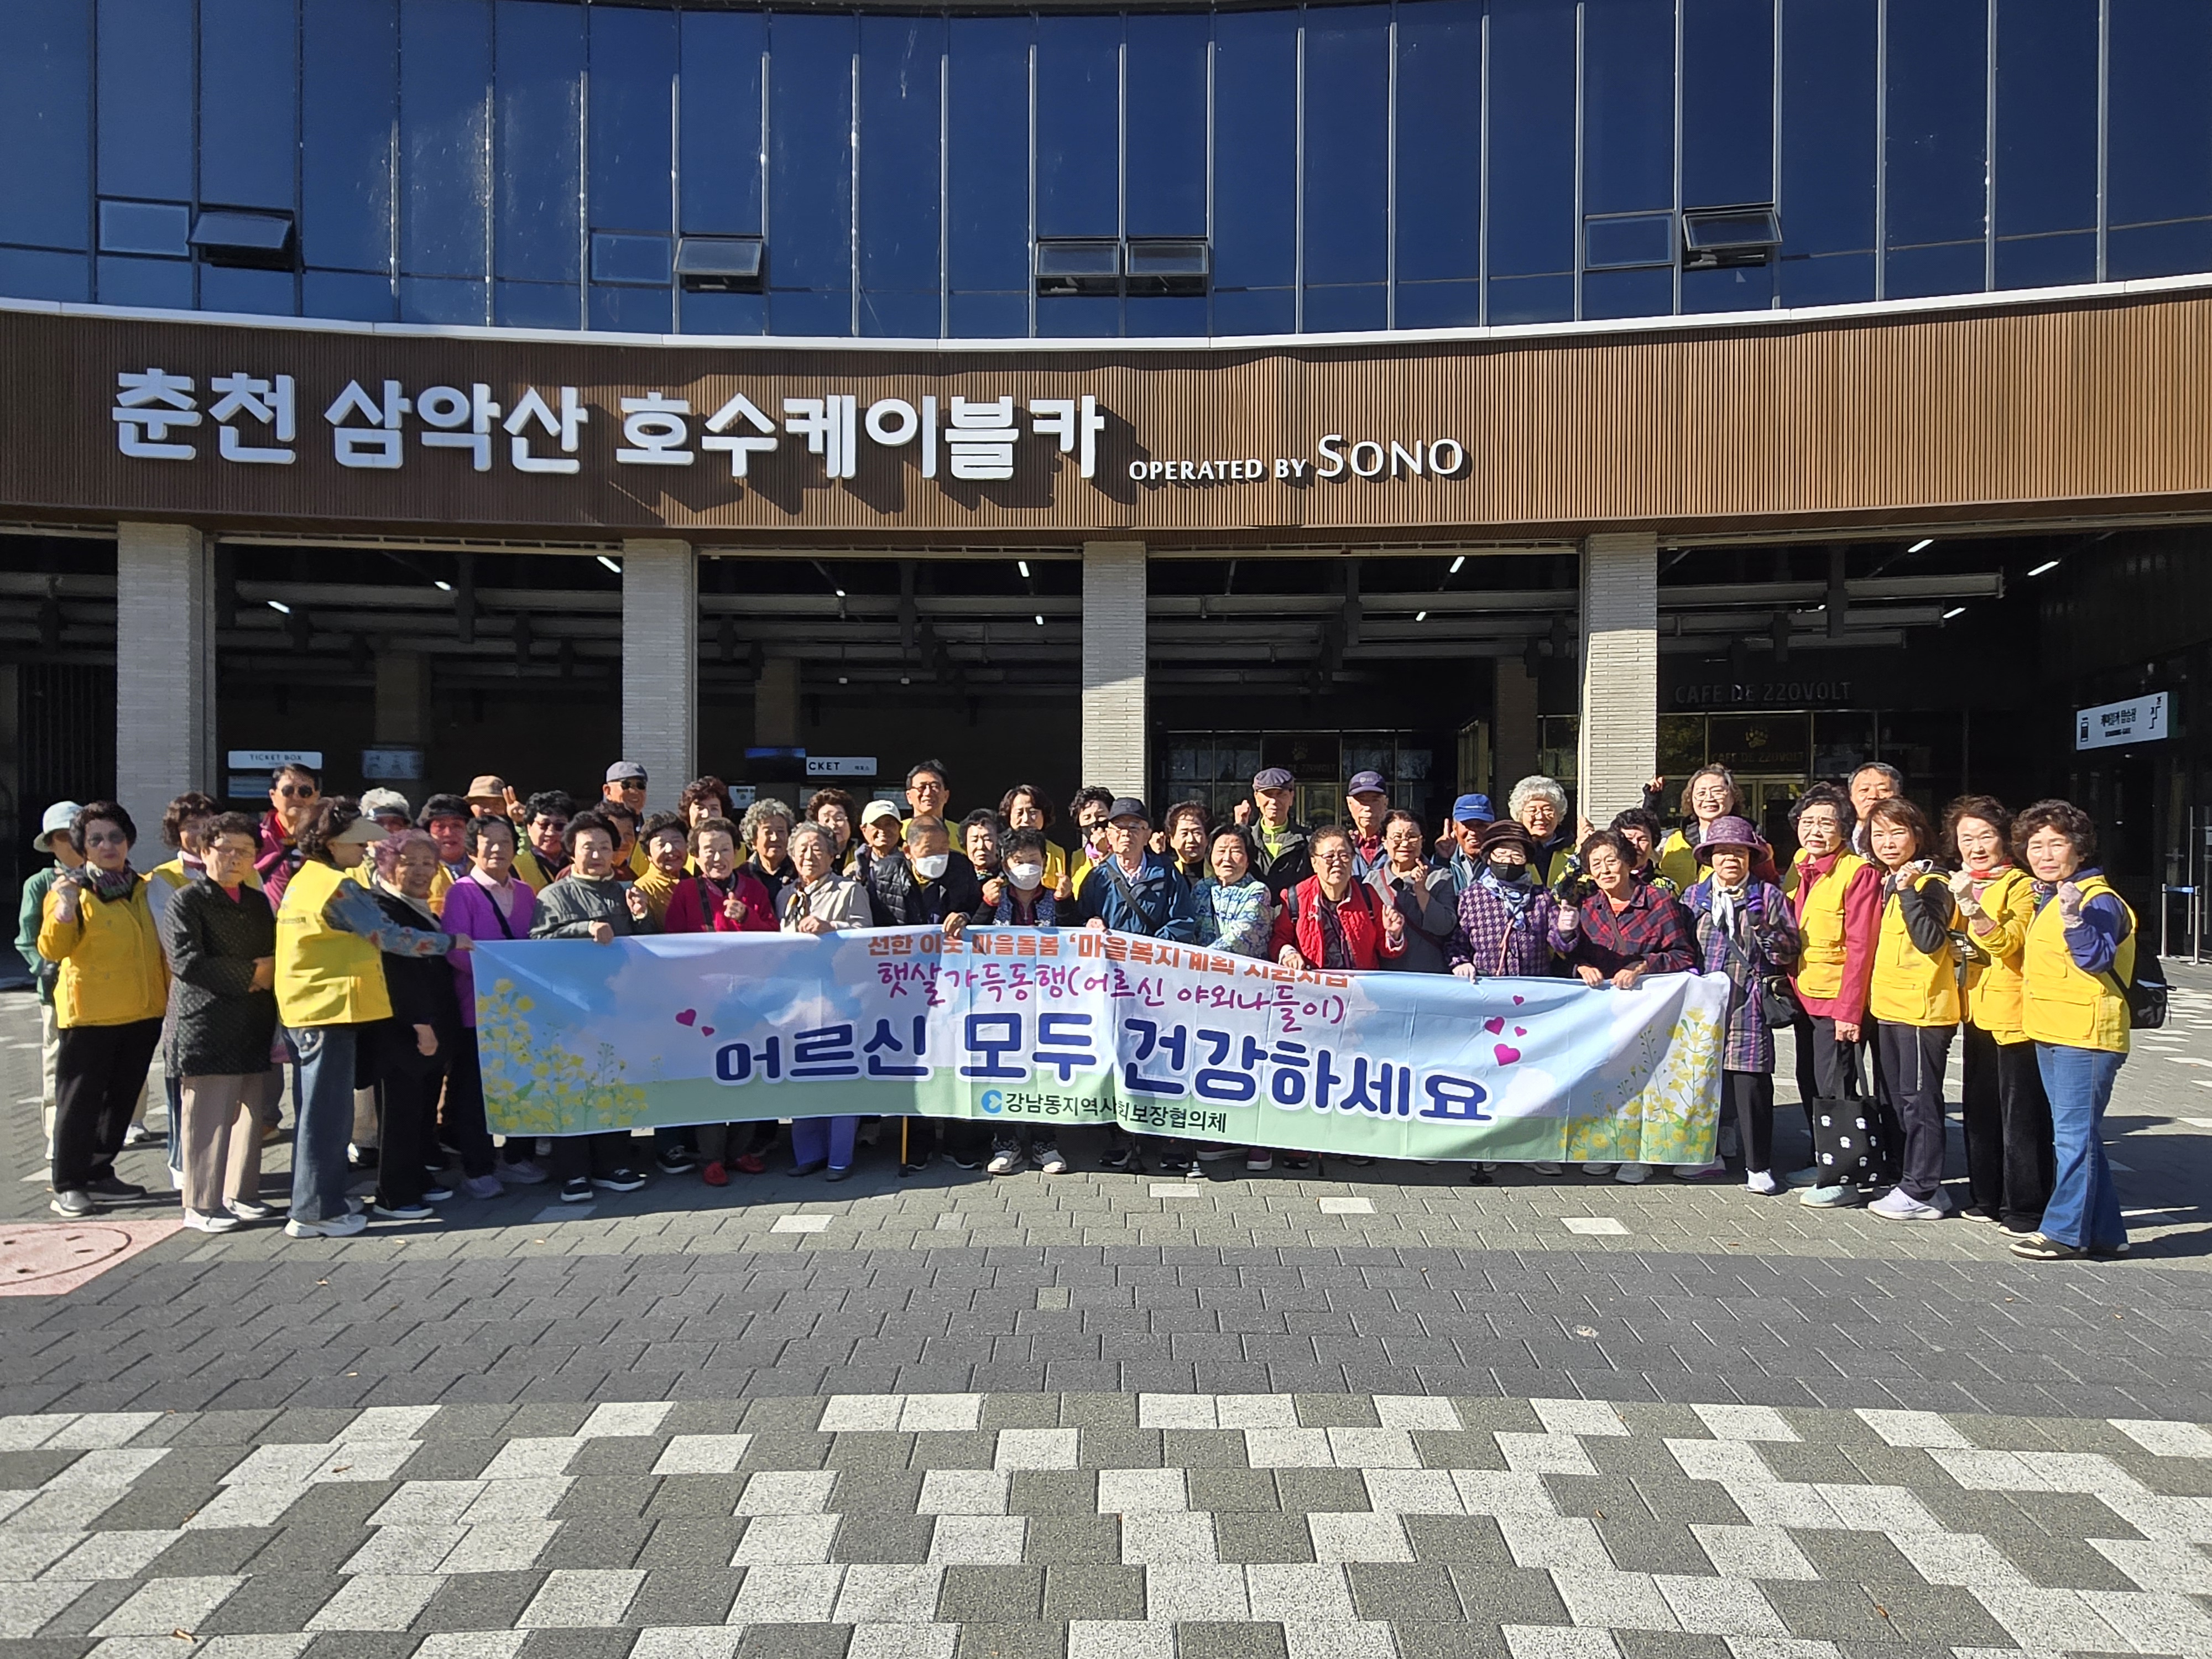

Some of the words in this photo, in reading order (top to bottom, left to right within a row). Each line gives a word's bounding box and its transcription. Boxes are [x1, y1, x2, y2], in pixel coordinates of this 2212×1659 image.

[112, 368, 296, 464] 춘천
[324, 379, 588, 474] 삼악산
[616, 391, 1105, 480] 호수케이블카
[1129, 458, 1263, 481] OPERATED
[1274, 458, 1307, 479] BY
[1316, 434, 1463, 477] SONO
[1675, 685, 1723, 704] CAFE
[1731, 684, 1756, 702] DE
[808, 761, 841, 771] CKET
[868, 934, 914, 956] 선한
[972, 932, 1059, 956] 마을돌봄
[1177, 984, 1345, 1033] 야외나들이)
[716, 1014, 930, 1082] 어르신
[959, 1012, 1097, 1082] 모두
[1123, 1016, 1493, 1121] 건강하세요
[1005, 1092, 1228, 1133] 강남동지역사회보장협의체
